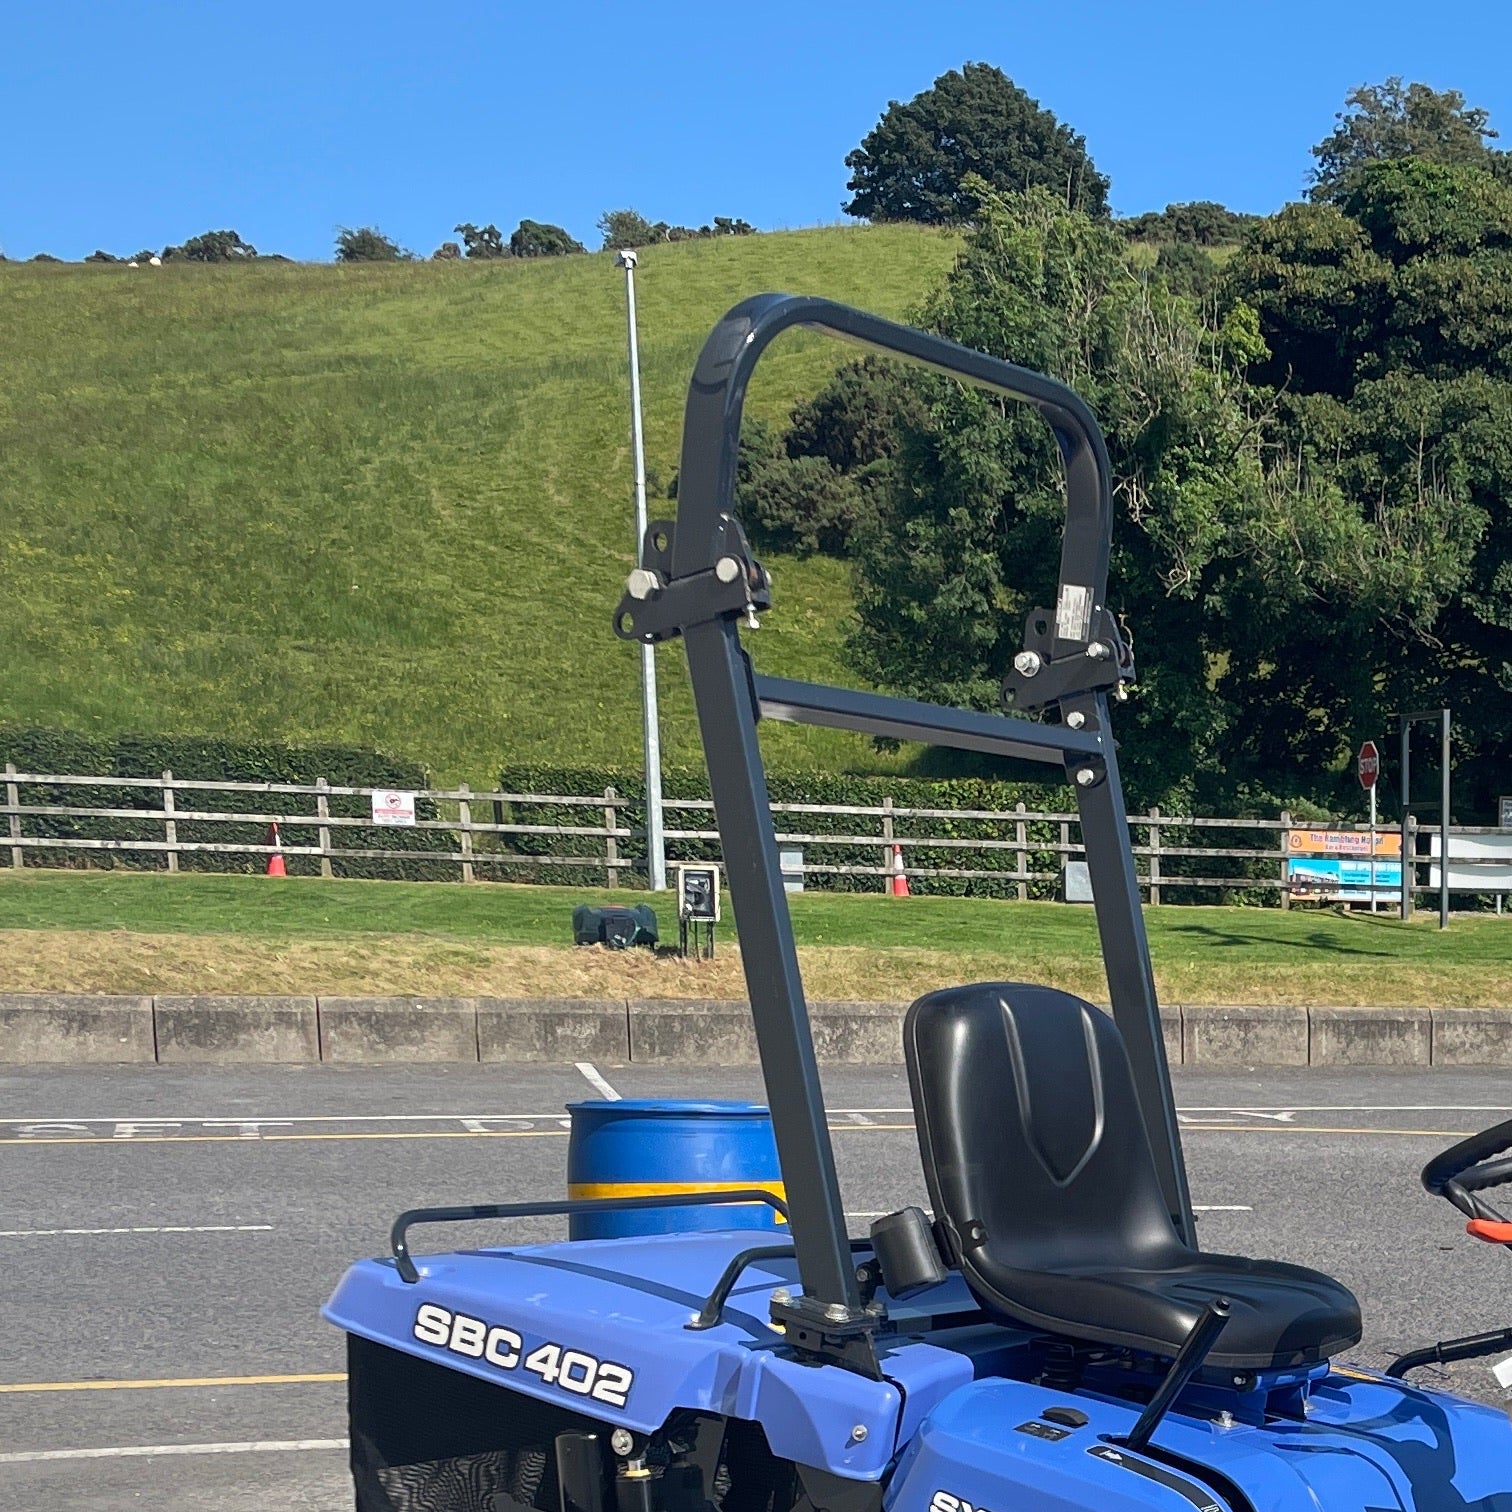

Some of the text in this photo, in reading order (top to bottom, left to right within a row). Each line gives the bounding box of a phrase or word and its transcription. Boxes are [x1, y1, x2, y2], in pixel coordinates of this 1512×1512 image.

[1360, 757, 1378, 774] STOP
[1310, 834, 1322, 842] The
[413, 1302, 634, 1409] SBC 402
